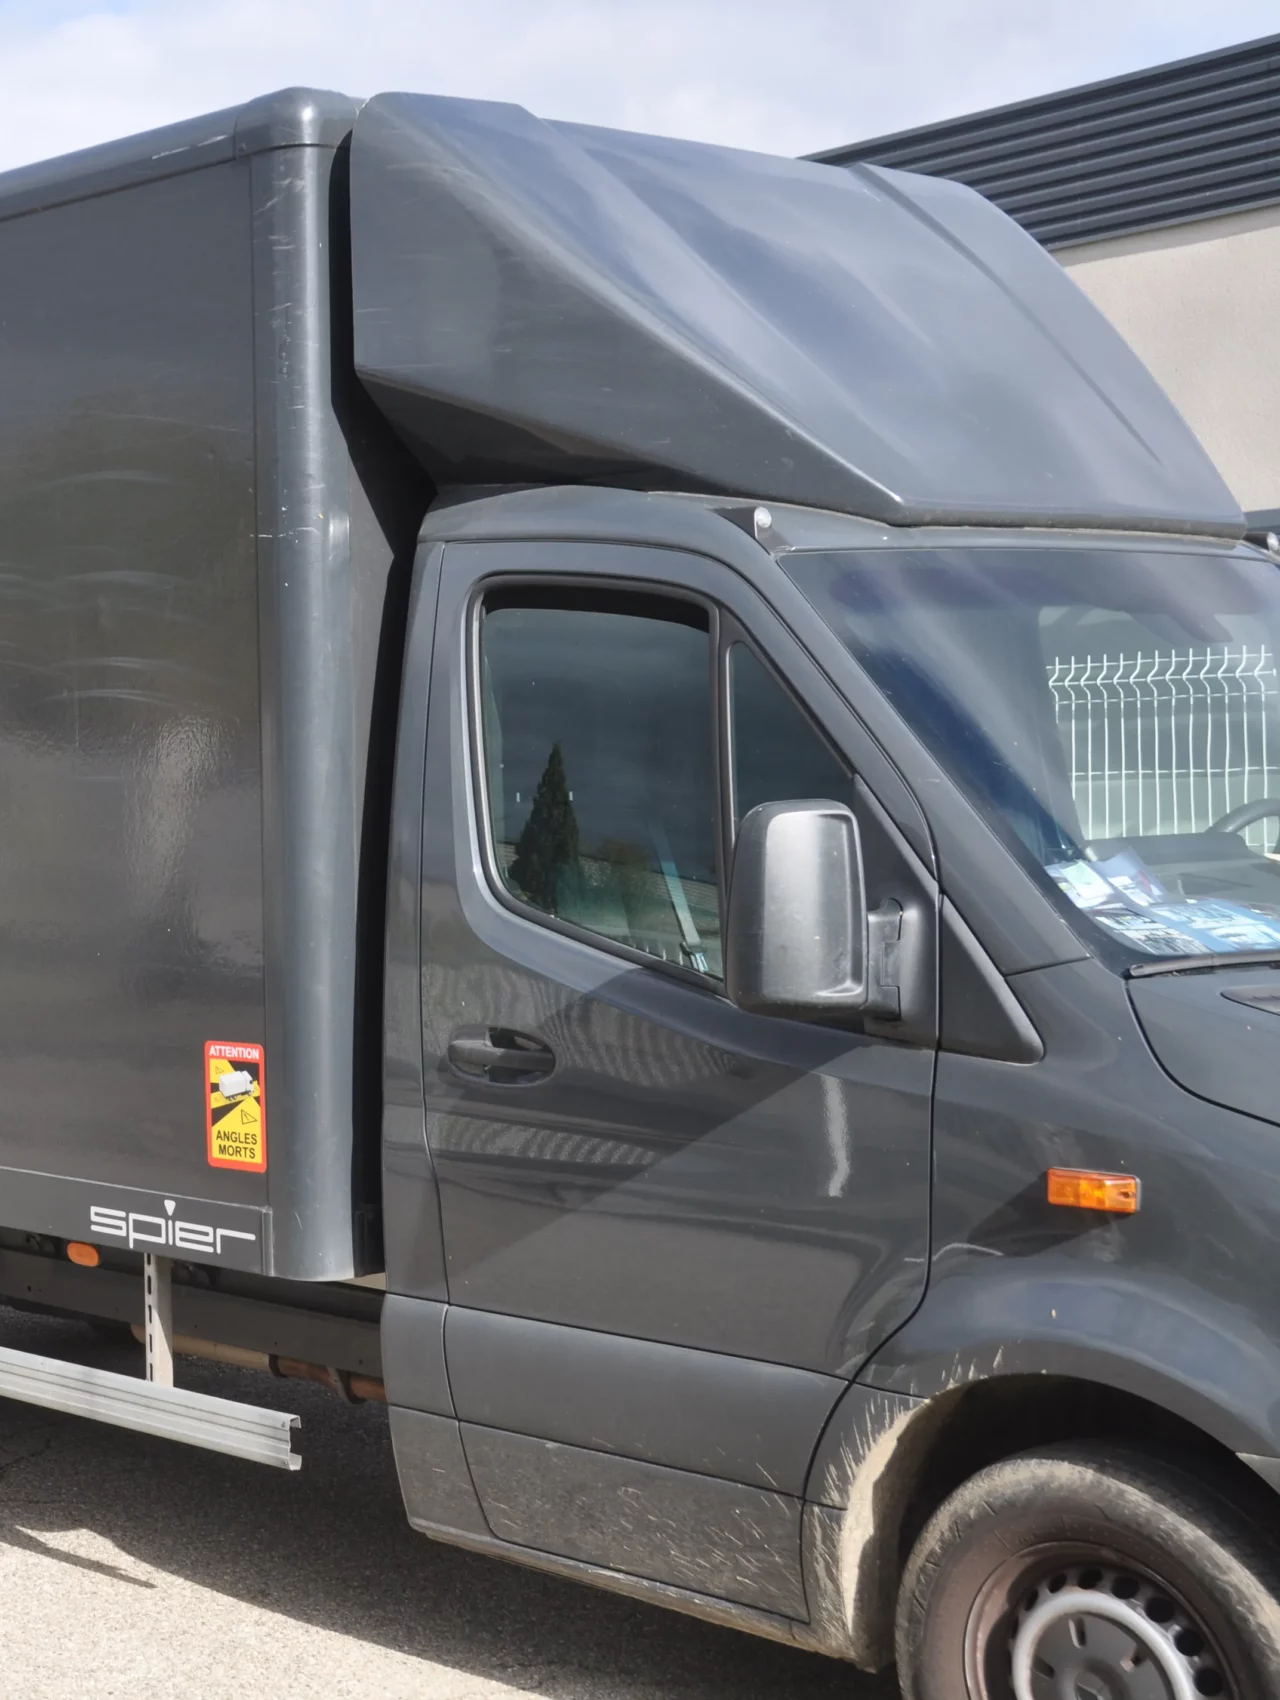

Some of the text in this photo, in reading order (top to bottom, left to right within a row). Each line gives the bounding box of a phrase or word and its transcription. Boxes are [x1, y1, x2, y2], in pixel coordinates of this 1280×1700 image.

[209, 1045, 260, 1060] ATTENTION
[216, 1130, 257, 1145] ANGLES
[218, 1144, 256, 1159] MORTS
[90, 1199, 256, 1254] spier
